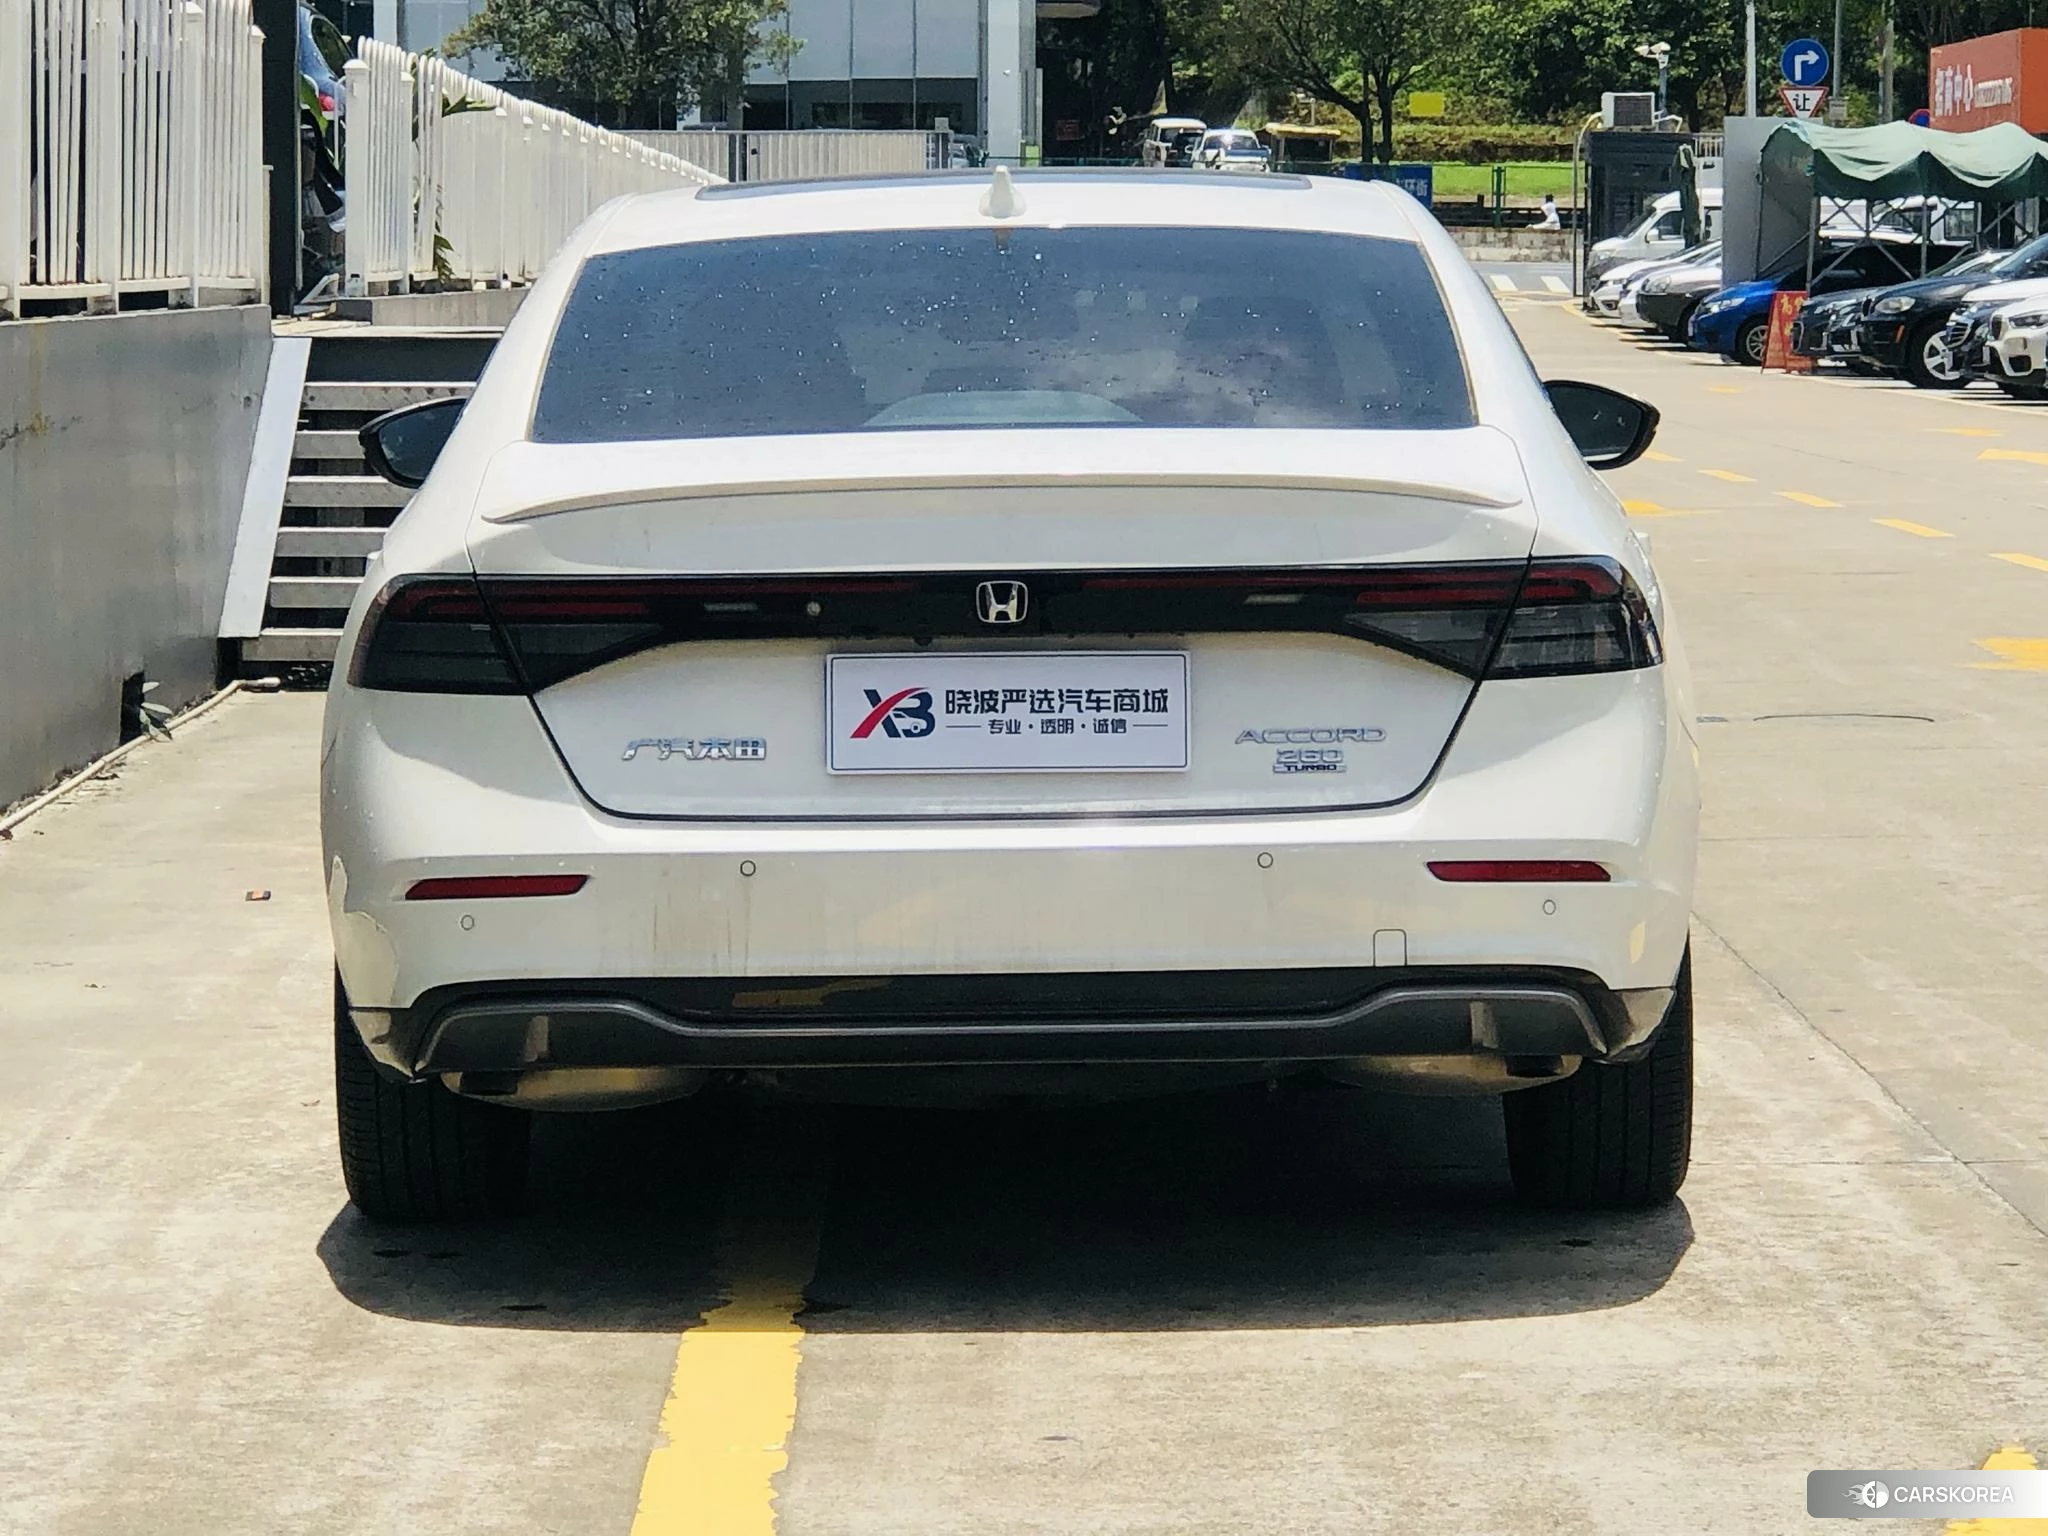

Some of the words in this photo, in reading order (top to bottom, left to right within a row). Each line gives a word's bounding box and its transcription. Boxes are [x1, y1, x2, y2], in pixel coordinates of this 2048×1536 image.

[1793, 93, 1811, 111] 让
[945, 688, 1168, 714] 晓波严选汽车商城
[1235, 728, 1388, 744] ACCORD
[621, 738, 767, 761] 广汽本田
[1277, 749, 1345, 764] 260
[1285, 763, 1338, 773] TURBO
